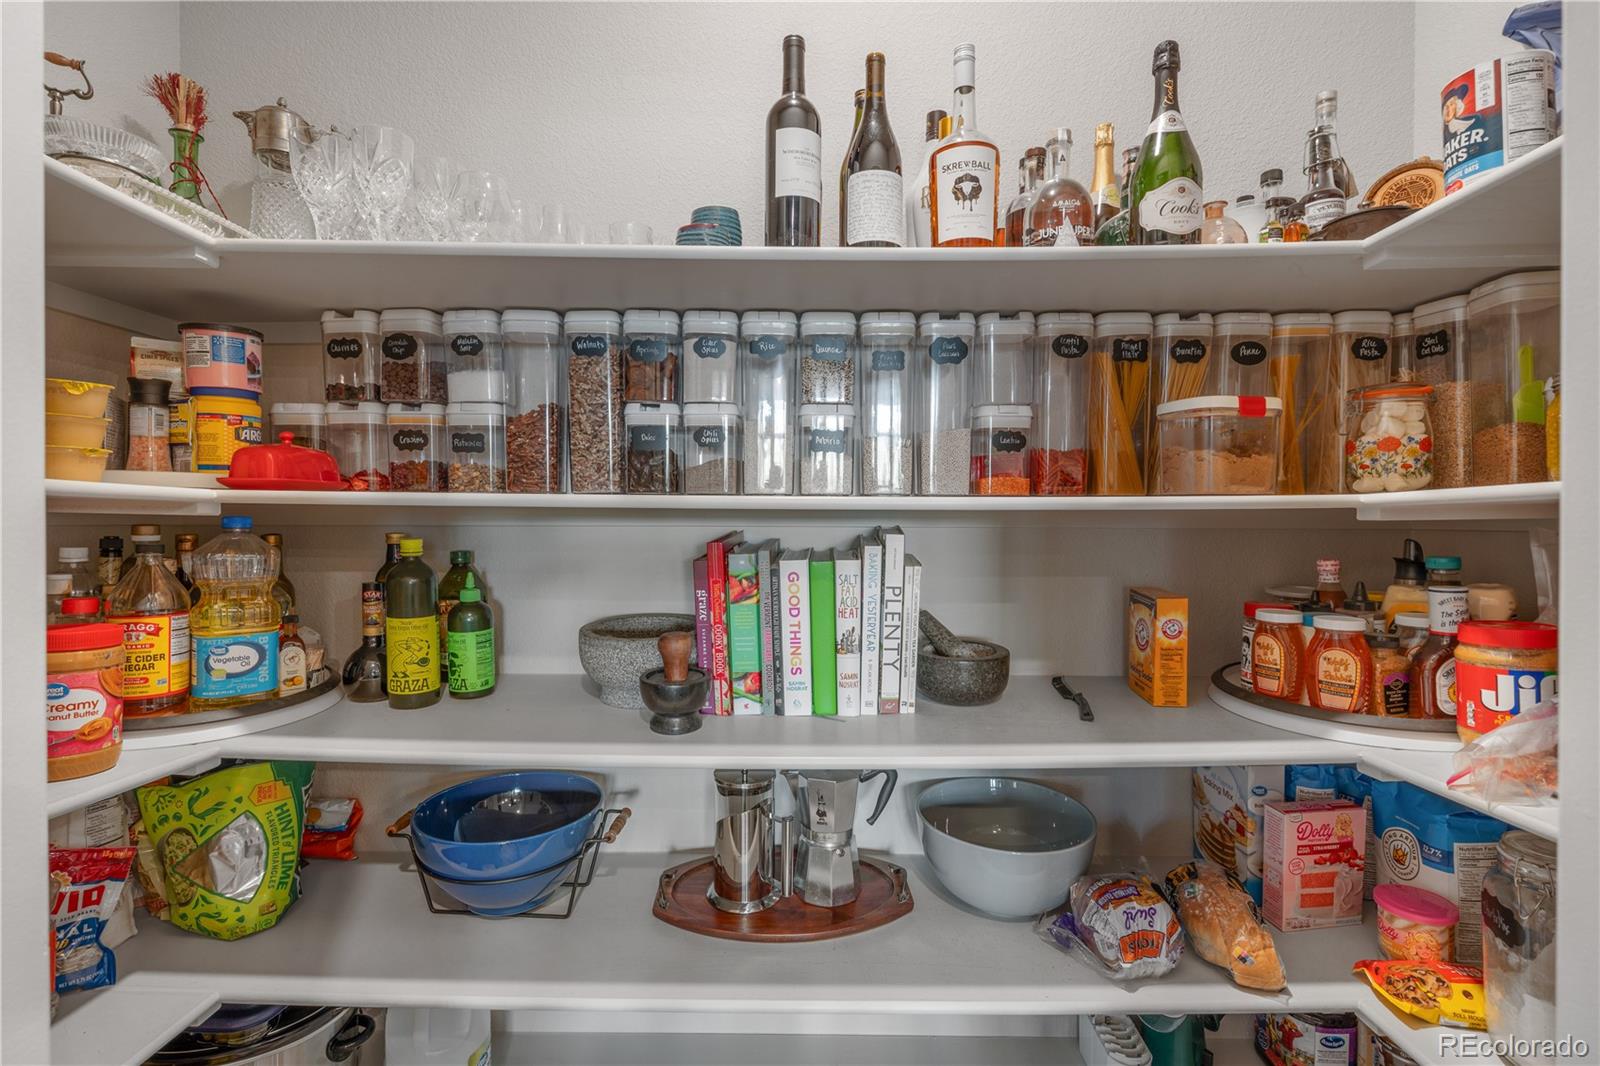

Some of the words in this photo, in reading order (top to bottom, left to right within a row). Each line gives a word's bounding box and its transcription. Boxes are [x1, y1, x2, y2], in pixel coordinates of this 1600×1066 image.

[1444, 128, 1489, 157] AKER.
[942, 160, 991, 173] SKREWBALL
[1445, 148, 1468, 172] ATS
[1154, 199, 1199, 217] Cook's
[576, 341, 605, 349] Walnuts
[760, 341, 776, 350] Rice
[1239, 346, 1261, 356] Penne
[1360, 348, 1381, 357] Pasta
[838, 574, 859, 585] SALT
[868, 552, 878, 589] BAKING
[788, 571, 801, 617] GOOD
[841, 586, 857, 597] FAT
[696, 590, 708, 621] graze
[839, 597, 858, 607] ACID
[763, 602, 772, 628] VERMONT
[838, 607, 859, 619] HEAT
[123, 623, 155, 632] RAGG
[866, 594, 877, 652] YESTERYEAR
[883, 586, 902, 671] PLENTY
[713, 624, 724, 650] COOKY
[789, 621, 803, 675] THINGS
[135, 653, 166, 663] CIDER
[212, 654, 251, 665] Vegetable
[715, 653, 726, 674] BOOK
[389, 677, 430, 692] GRAZA
[838, 680, 859, 689] NOSRAT
[840, 672, 858, 680] SAMIN
[47, 699, 100, 713] reamy
[73, 710, 100, 720] Butter
[265, 811, 280, 847] FLAVORED
[275, 802, 295, 840] HINT
[1297, 821, 1334, 841] Dolly
[1385, 831, 1398, 845] KING
[1399, 834, 1417, 862] ARTHUR
[268, 847, 280, 889] TRIANGLES
[277, 850, 296, 890] LIME
[1378, 918, 1399, 940] Dolly
